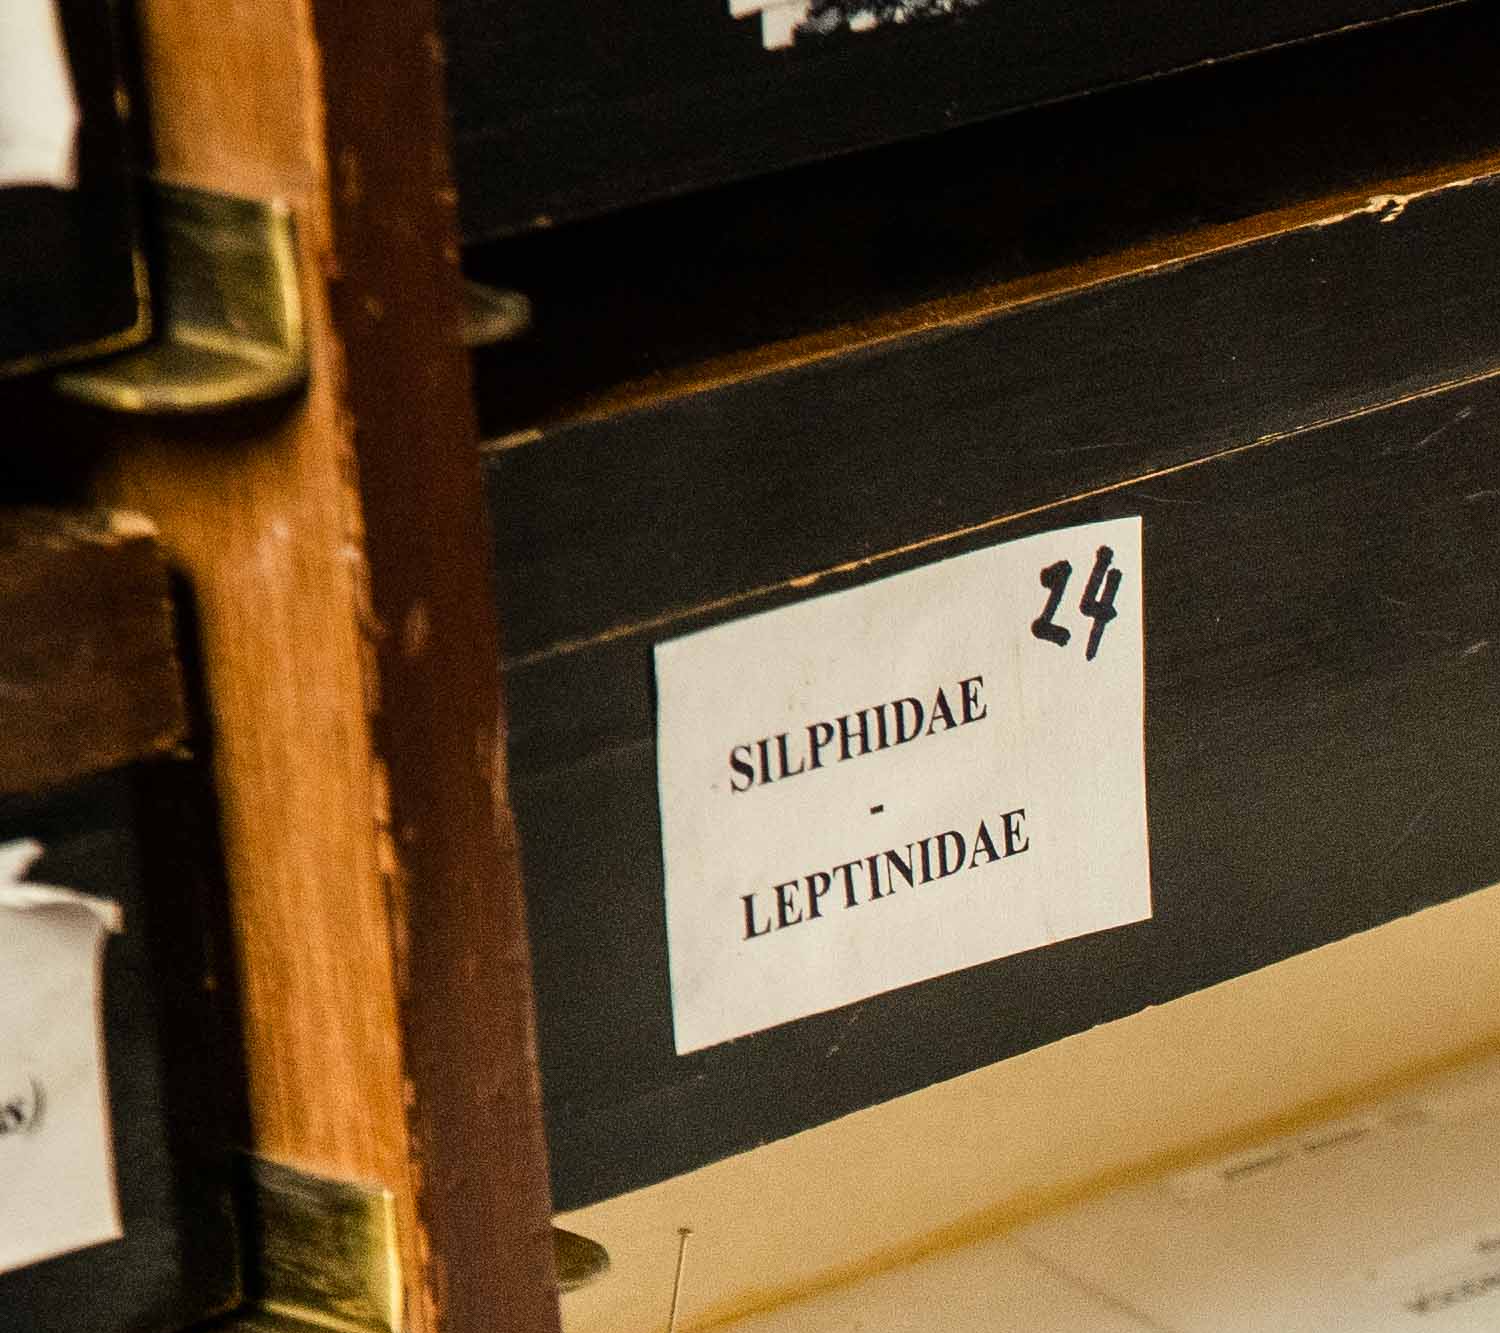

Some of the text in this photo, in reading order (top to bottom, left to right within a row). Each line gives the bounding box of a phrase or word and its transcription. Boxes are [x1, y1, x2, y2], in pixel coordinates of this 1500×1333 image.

[1030, 544, 1123, 661] 24
[728, 676, 989, 794] SILPHIDAE
[740, 808, 1031, 943] LEPTINIDAE
